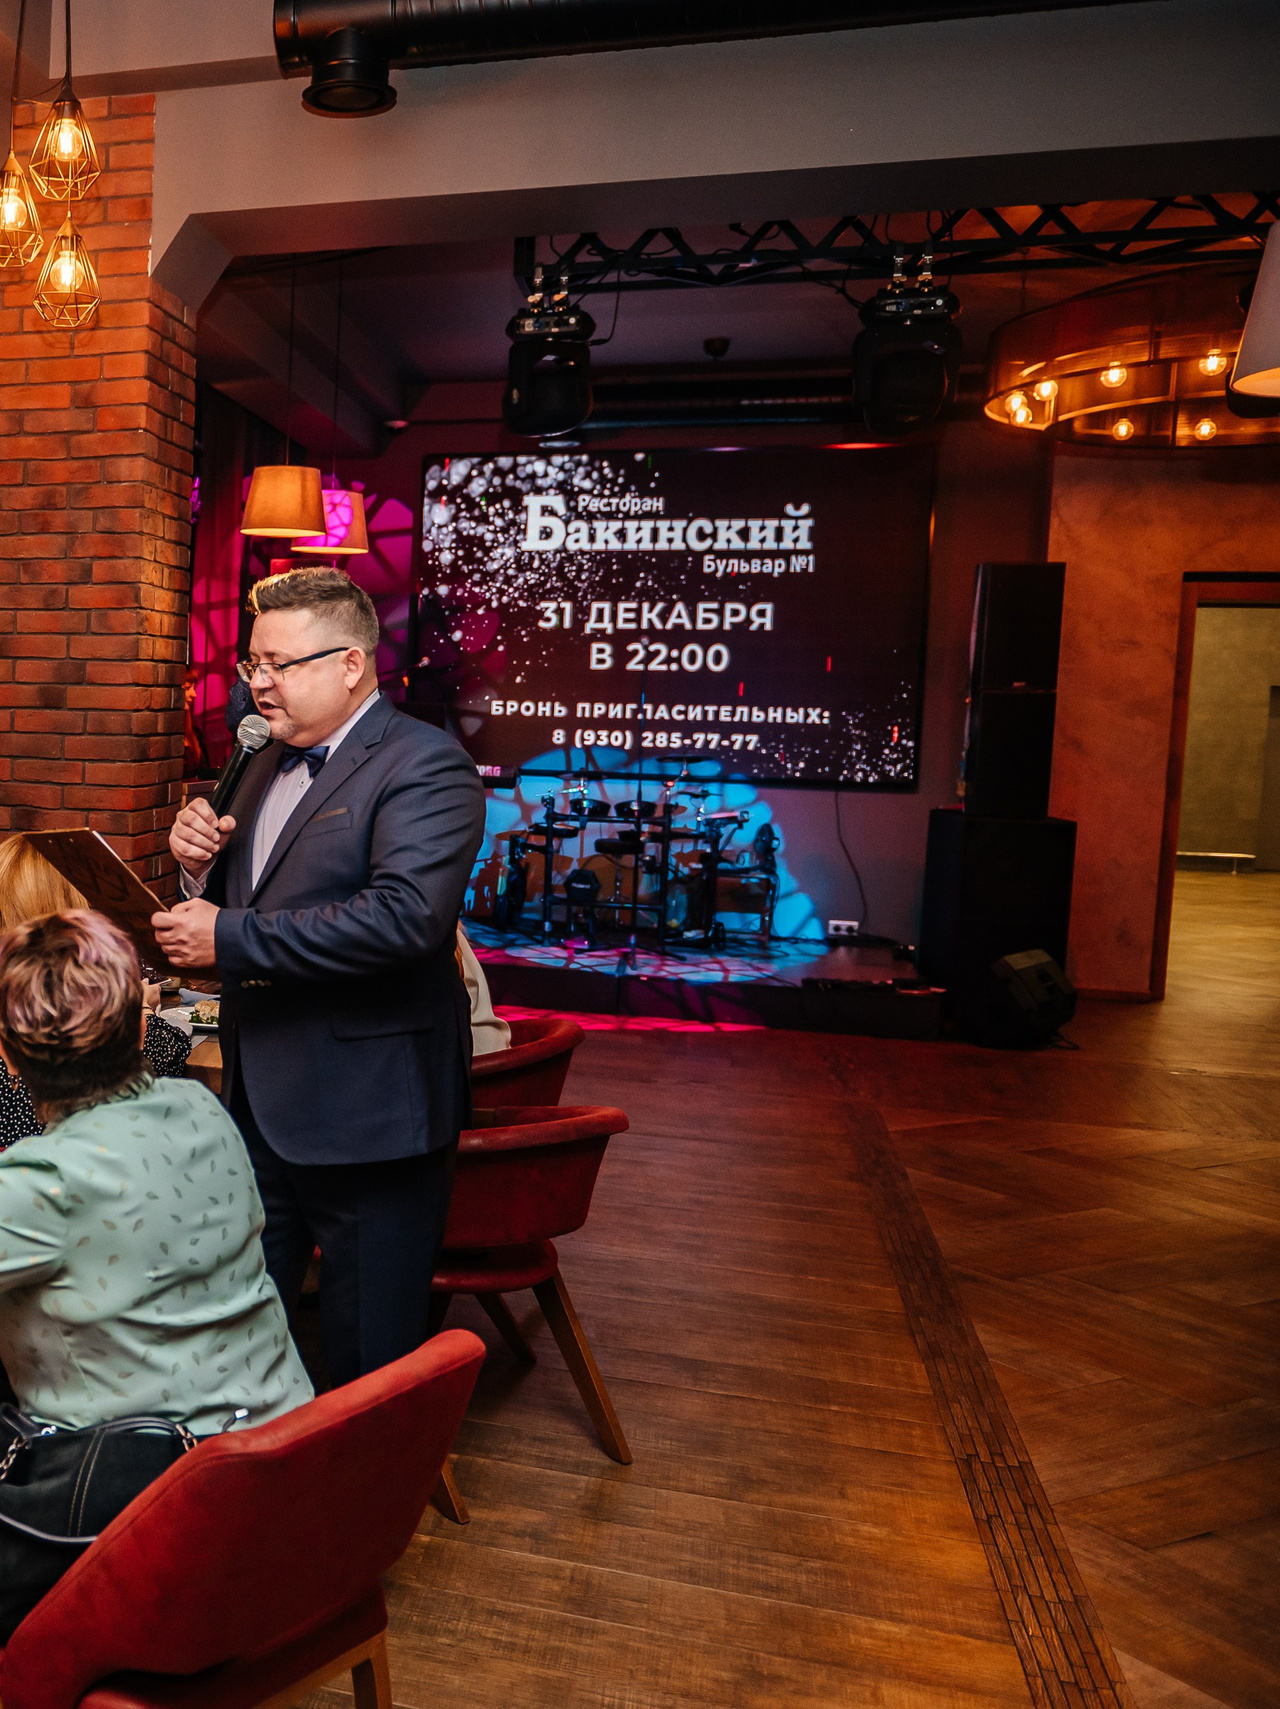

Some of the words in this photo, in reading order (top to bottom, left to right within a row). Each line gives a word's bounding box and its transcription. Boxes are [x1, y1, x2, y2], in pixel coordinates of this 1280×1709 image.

[577, 495, 664, 515] Ресторан
[521, 494, 814, 551] Бакинский
[703, 553, 786, 577] Бульвар
[788, 553, 816, 574] №1
[538, 601, 573, 629] 31
[584, 601, 773, 633] ДЕКАБРЯ
[589, 642, 614, 670] В
[626, 643, 730, 672] 22:00
[491, 700, 567, 717] БРОНЬ
[551, 729, 565, 745] 8
[574, 728, 632, 750] (930)
[641, 731, 759, 751] 285-77-77
[476, 765, 501, 776] ORG
